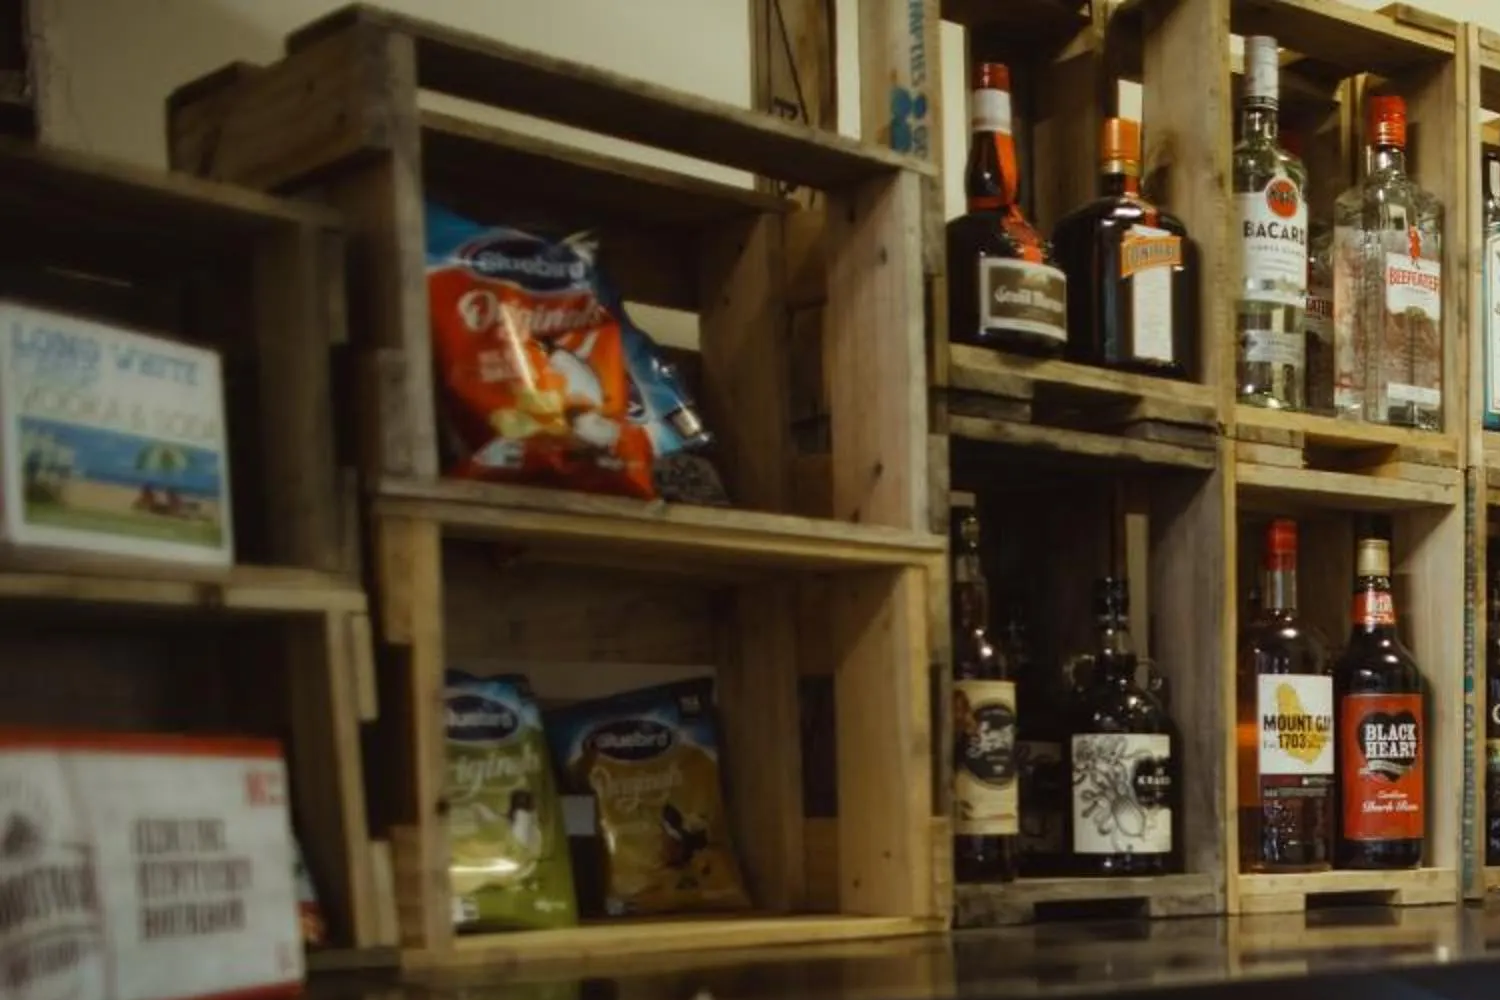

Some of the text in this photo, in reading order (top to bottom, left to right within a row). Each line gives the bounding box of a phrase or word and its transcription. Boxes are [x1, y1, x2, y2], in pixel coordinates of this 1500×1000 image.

[1263, 715, 1312, 732] MOUNT
[1364, 723, 1417, 741] BLACK
[1278, 733, 1308, 750] 1703
[1365, 741, 1417, 759] HEART
